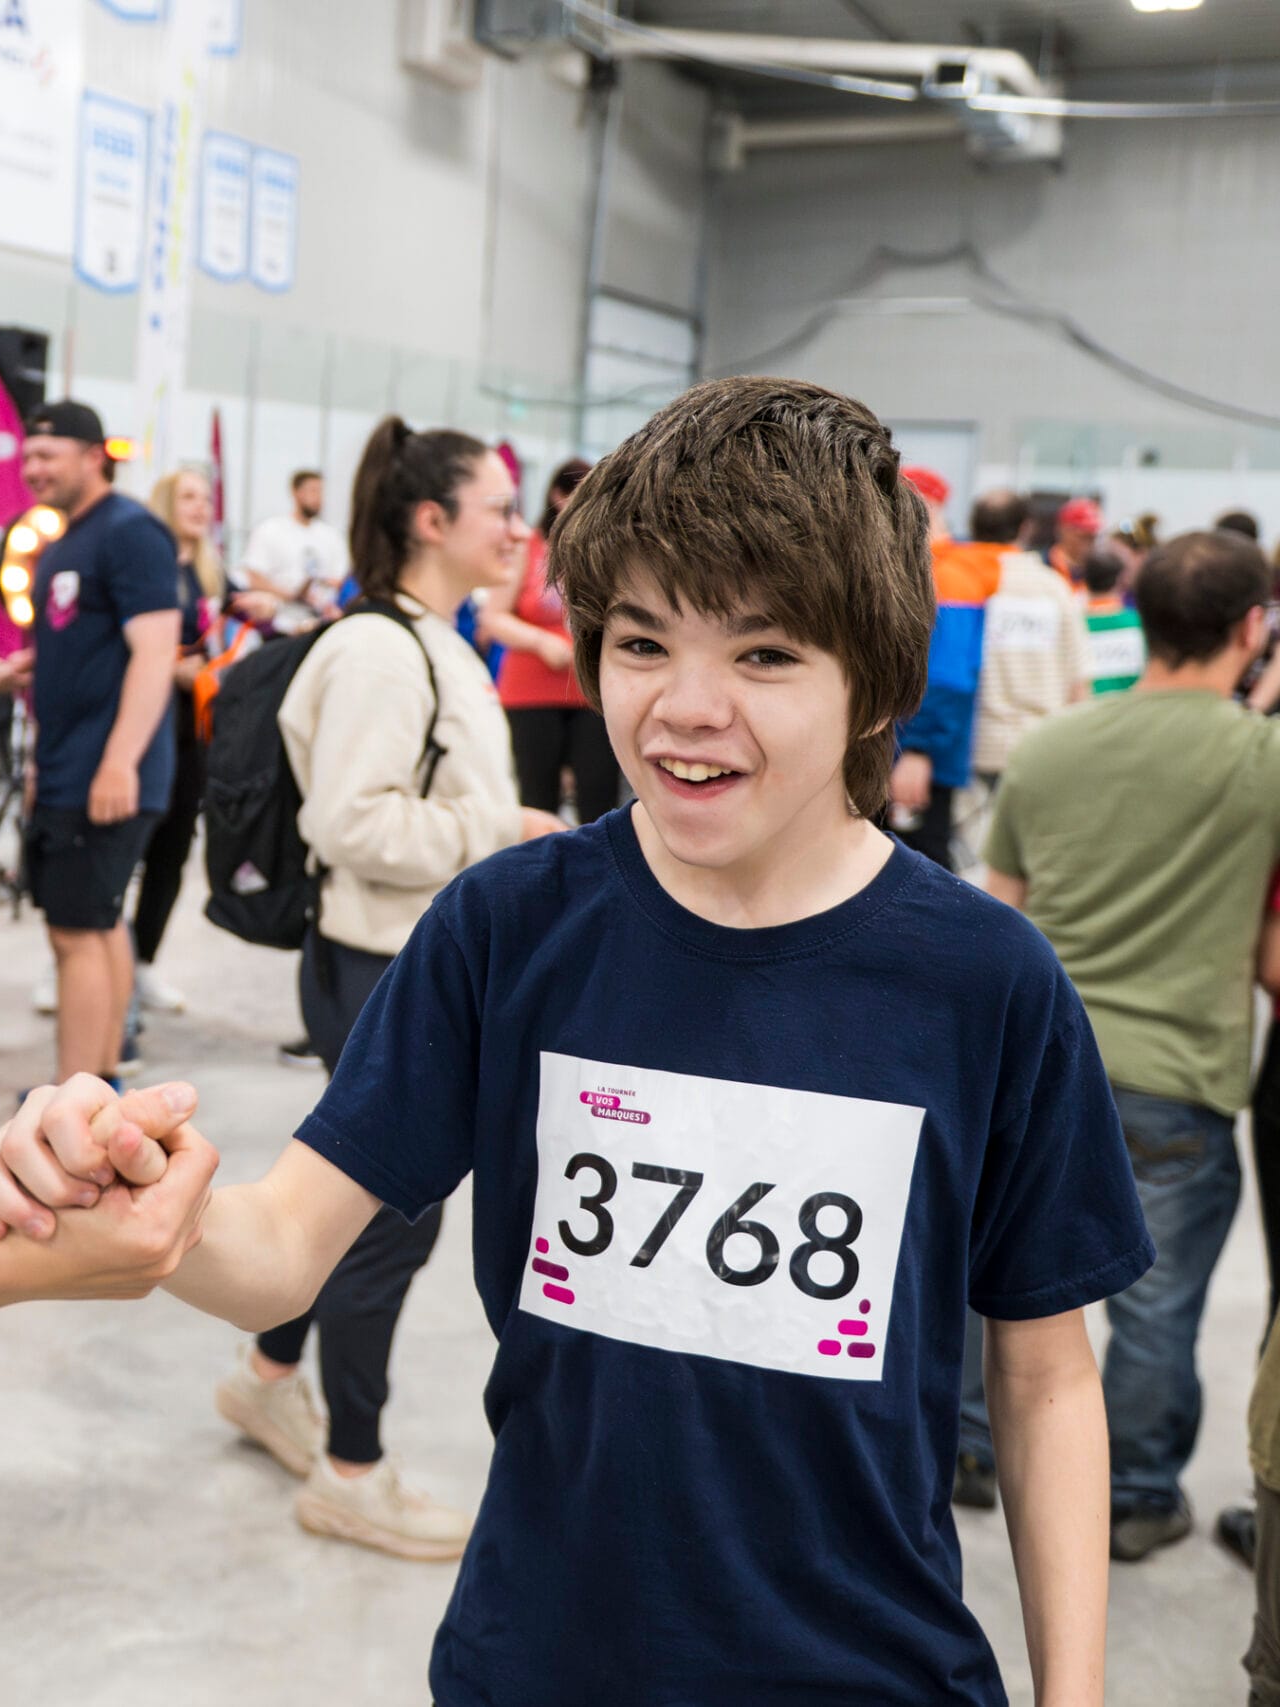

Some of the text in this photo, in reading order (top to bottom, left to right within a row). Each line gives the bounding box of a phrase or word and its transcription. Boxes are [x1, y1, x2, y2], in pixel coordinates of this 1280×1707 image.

[586, 1093, 614, 1106] À VOS
[597, 1107, 644, 1122] MARQUES!
[558, 1152, 863, 1300] 3768
